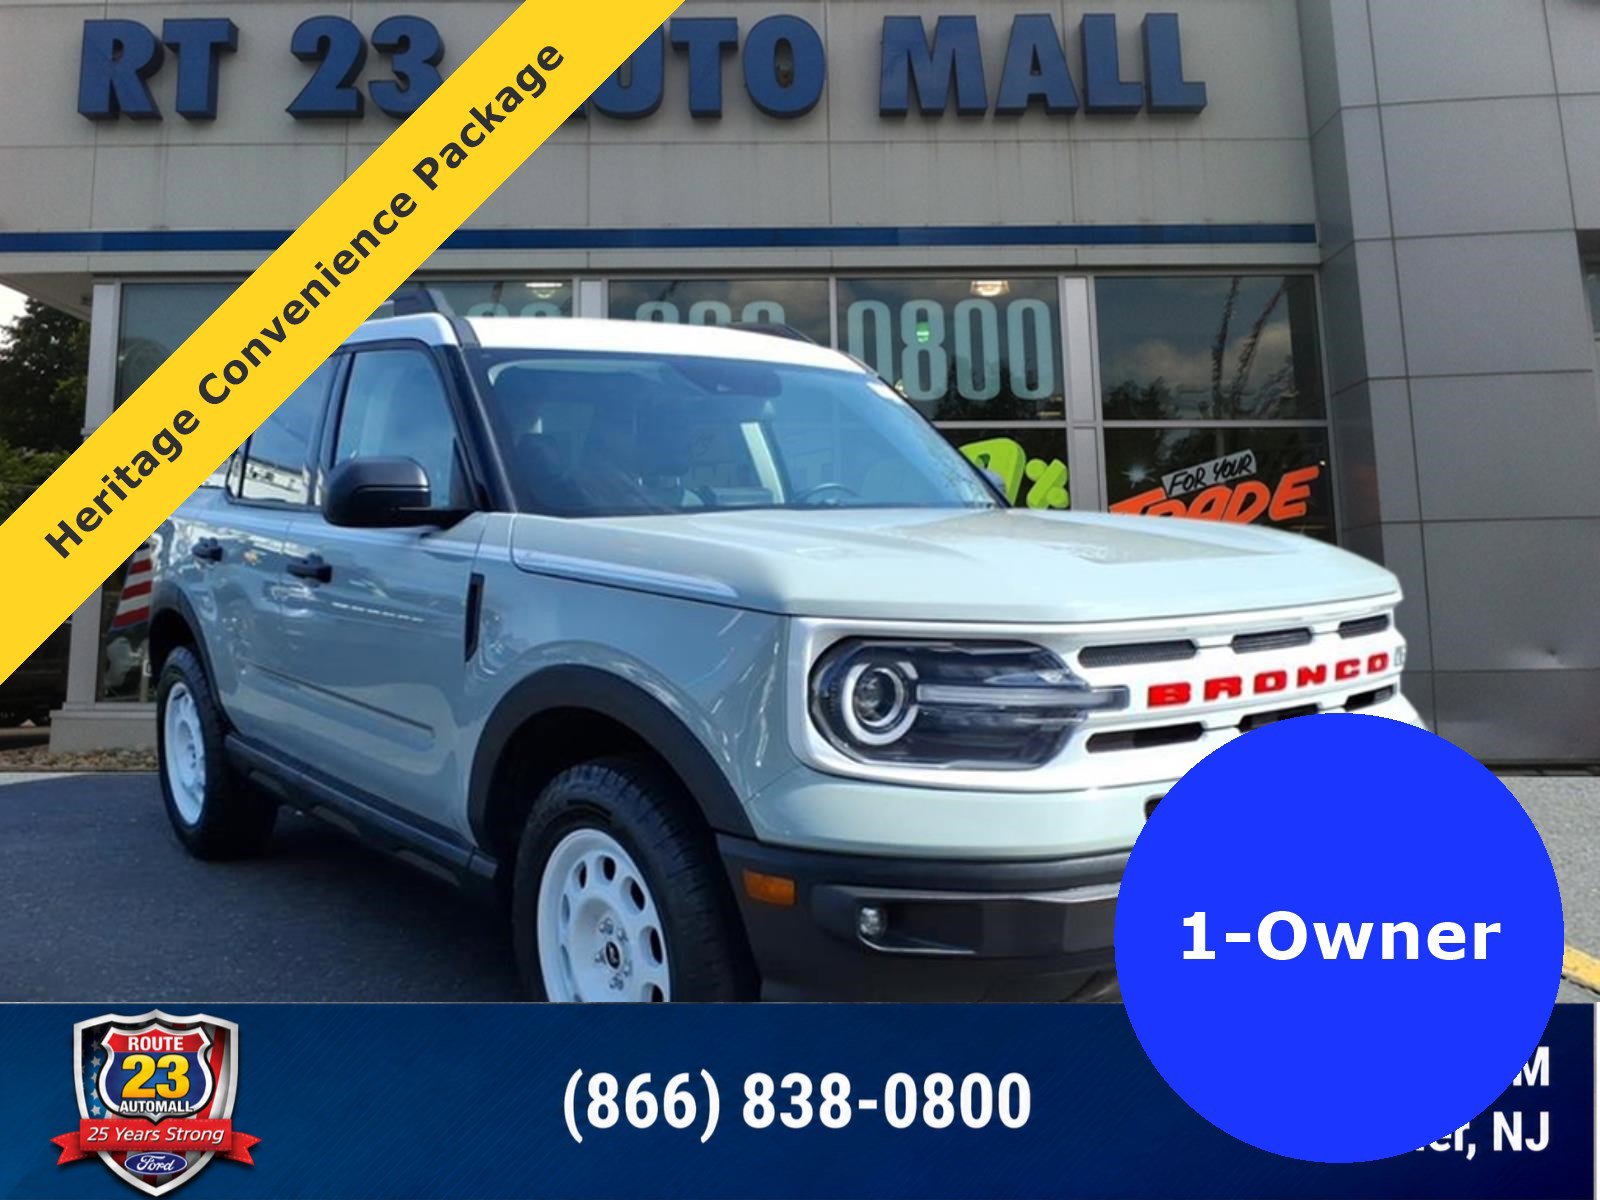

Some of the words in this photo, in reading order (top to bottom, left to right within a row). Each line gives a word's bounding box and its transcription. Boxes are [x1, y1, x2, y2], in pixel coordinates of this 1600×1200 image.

[78, 18, 239, 120] RT
[285, 15, 445, 120] 23
[566, 14, 827, 119] UTO
[879, 13, 1208, 118] MALL
[847, 299, 1054, 400] 0800
[1168, 468, 1206, 496] FOR
[1213, 453, 1253, 481] YOUR
[1147, 652, 1389, 709] BRONCO
